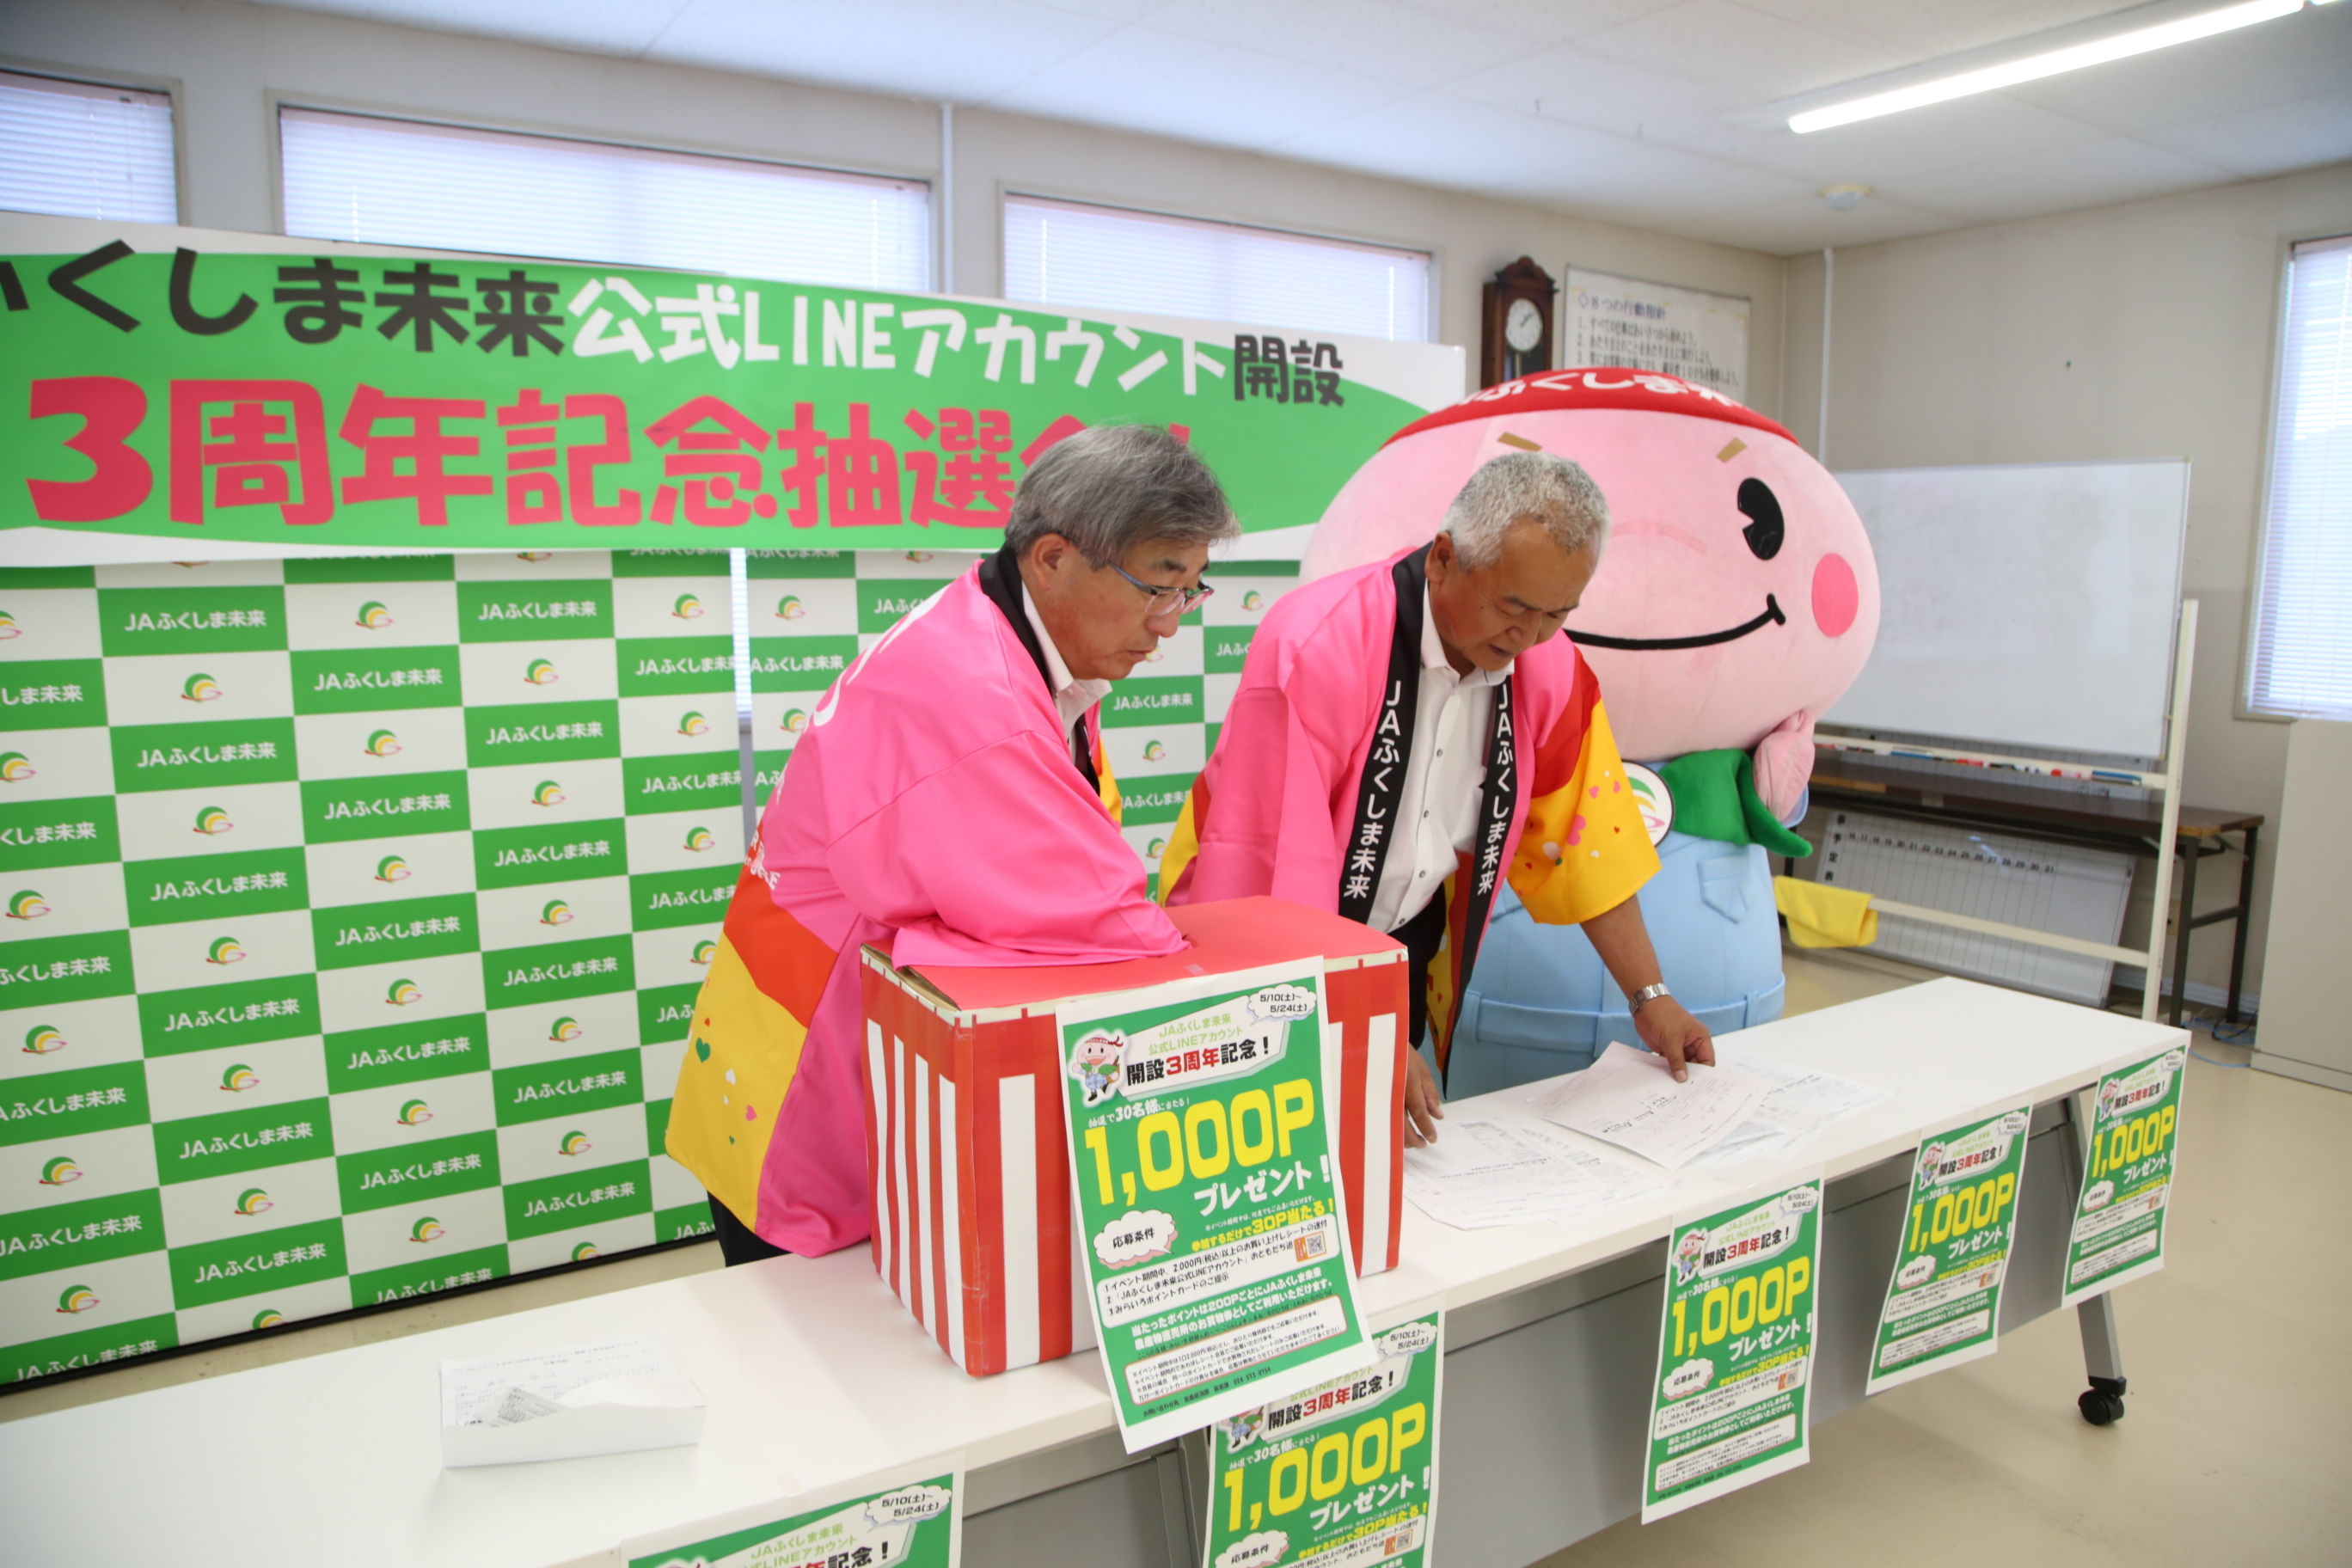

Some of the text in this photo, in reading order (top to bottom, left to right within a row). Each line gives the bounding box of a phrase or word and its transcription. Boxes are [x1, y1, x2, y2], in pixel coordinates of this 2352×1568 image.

[0, 239, 1344, 407] くしま未来公式LINEアカウント開設
[25, 375, 1191, 529] 3周年記念抽選
[125, 609, 266, 632] JAふくしま未来
[478, 601, 598, 621] JAふくしま未来
[0, 684, 84, 706] しま未来
[314, 668, 443, 691] JAふくしま未来
[1113, 693, 1193, 710] JAふくしま未来
[486, 721, 603, 744] JAふくしま未来
[137, 741, 277, 768] JAふくしま未来
[324, 793, 451, 820] JAふくしま未来
[1344, 680, 1402, 899] JAふくしま未来
[1477, 683, 1514, 897] JAふくしま未来
[494, 840, 610, 867] JAふくしま未来
[1860, 833, 1868, 842] 17
[1885, 837, 1892, 846] 19
[1896, 839, 1905, 848] 20
[1934, 846, 1944, 855] 23
[1947, 848, 1957, 857] 24
[1961, 850, 1969, 860] 25
[1974, 853, 1983, 862] 26
[1988, 854, 1997, 864] 27
[2001, 857, 2012, 867] 28
[2016, 860, 2025, 869] 29
[2030, 862, 2040, 872] 30
[2044, 865, 2054, 874] 31
[150, 871, 289, 901] JAふくしま未来
[335, 916, 461, 946] JAふくしま未来
[504, 956, 618, 987] JAふくしま未来
[164, 998, 301, 1032] JAふくしま未来
[1270, 1002, 1308, 1014] 5/24(土)
[1148, 1026, 1243, 1056] 公式LINEアカウント
[1159, 1013, 1232, 1038] JAふくしま未来
[347, 1036, 471, 1069] JAふくしま未来
[1126, 1036, 1269, 1087] 開設3周年記念！
[513, 1070, 627, 1104] JAふくしま未来
[179, 1121, 314, 1160] JAふくしま未来
[1084, 1078, 1315, 1207] 1,000P
[2092, 1104, 2176, 1179] 1,000P
[360, 1154, 482, 1191] JAふくしま未来
[1194, 1154, 1331, 1217] プレゼント！
[524, 1181, 636, 1218] JAふくしま未来
[1908, 1172, 2015, 1253] 1,000P
[1112, 1227, 1155, 1249] 応募条件
[1703, 1226, 1790, 1269] 開設3周年記念！
[1948, 1221, 2012, 1259] プレゼント！
[195, 1242, 328, 1284] JAふくしま未来
[1672, 1256, 1810, 1357] 1,000P
[1398, 1337, 1430, 1351] 5/24(土)
[1728, 1312, 1812, 1362] プレゼント！
[1268, 1370, 1394, 1431] 開設3周年記念！
[1223, 1401, 1426, 1533] 1,000P
[893, 1501, 940, 1518] 5/24(土)
[1309, 1465, 1430, 1532] プレゼント！
[739, 1534, 857, 1568] LINEアカウント
[750, 1522, 844, 1559] JAふくしま未来
[793, 1540, 889, 1568] 記念！
[1231, 1543, 1270, 1565] 応募条件
